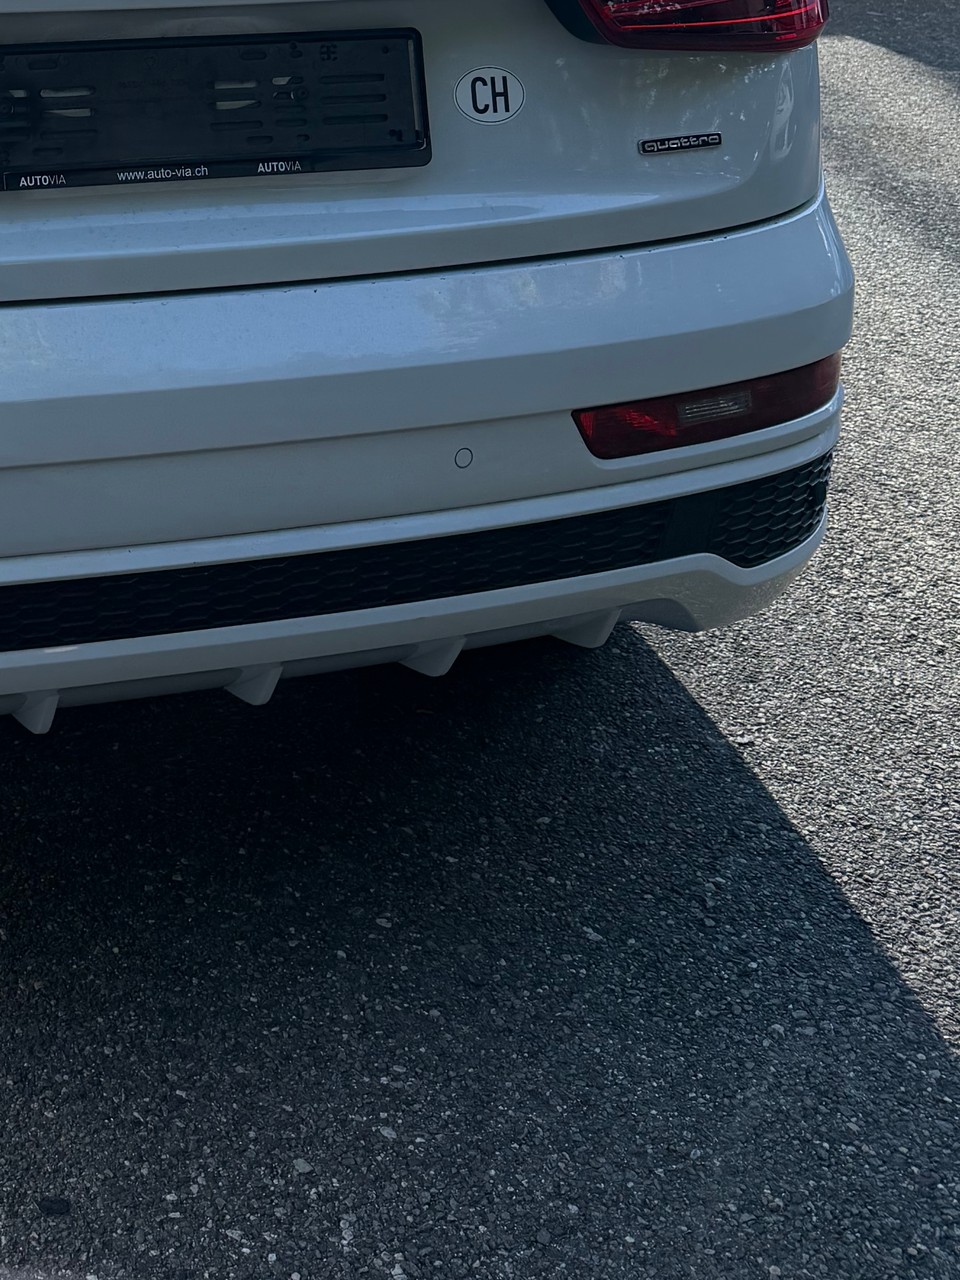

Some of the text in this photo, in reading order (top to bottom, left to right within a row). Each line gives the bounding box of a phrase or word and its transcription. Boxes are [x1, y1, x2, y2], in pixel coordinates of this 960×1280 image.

[470, 75, 511, 115] CH
[644, 133, 721, 152] quattro
[18, 160, 302, 188] AUTOVIA www.auto-via.ch AUTOVIA
